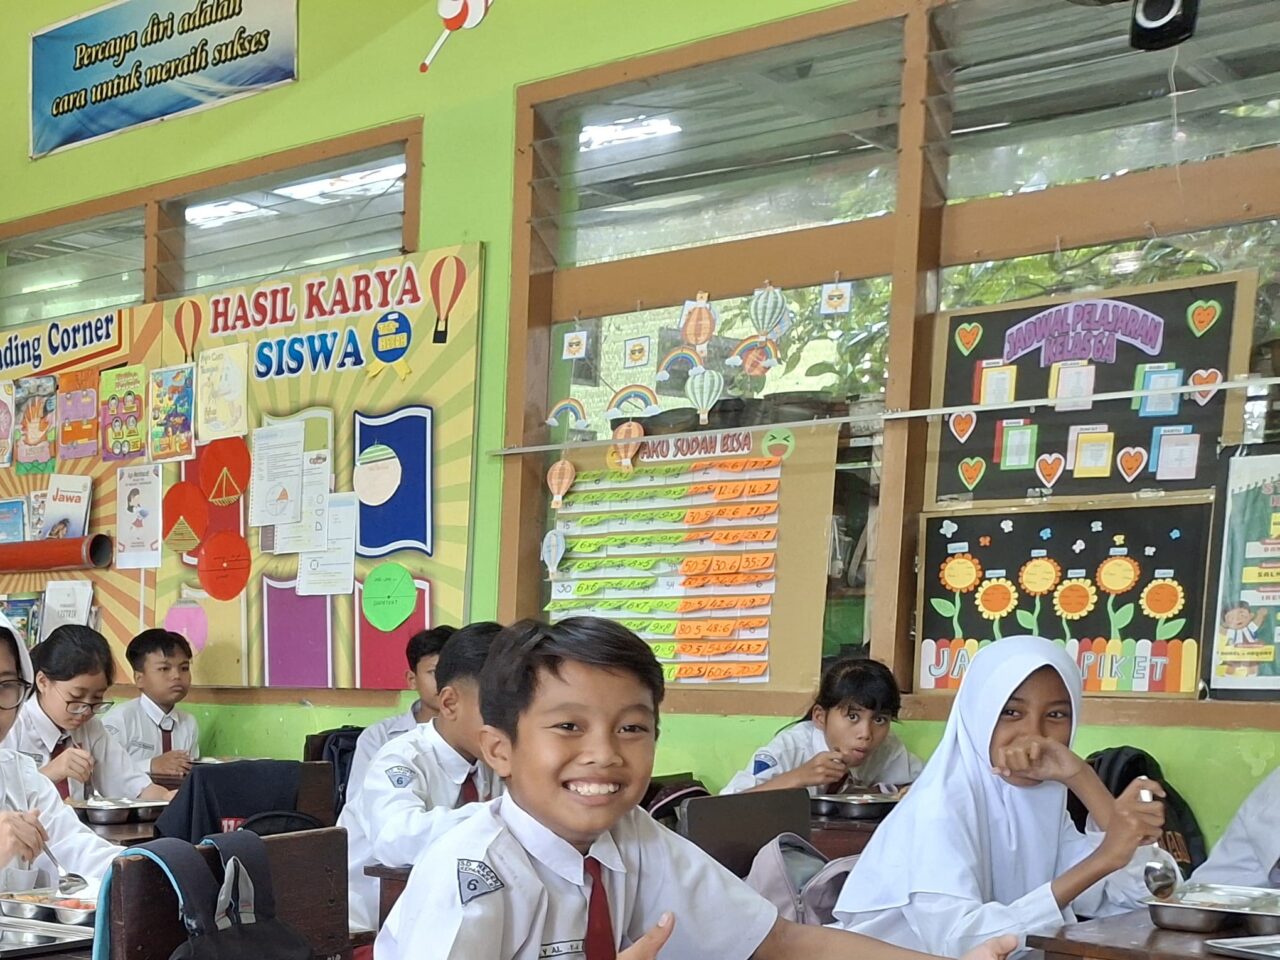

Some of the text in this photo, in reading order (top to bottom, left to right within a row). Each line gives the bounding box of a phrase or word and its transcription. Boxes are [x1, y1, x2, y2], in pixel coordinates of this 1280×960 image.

[74, 0, 242, 69] Percaya diri adalah
[51, 26, 269, 117] cara untuk meraih sukses
[211, 265, 422, 334] HASIL KARYA
[47, 313, 114, 356] Corner
[1006, 302, 1163, 358] JADWAL PELAJARAN
[1043, 332, 1118, 363] KELAS 6A
[254, 328, 365, 379] SISWA
[641, 431, 752, 460] AKU SUDAH BISA
[52, 488, 82, 504] Jawa
[1081, 652, 1169, 682] PIKET
[397, 776, 404, 785] 6
[466, 878, 480, 892] 6
